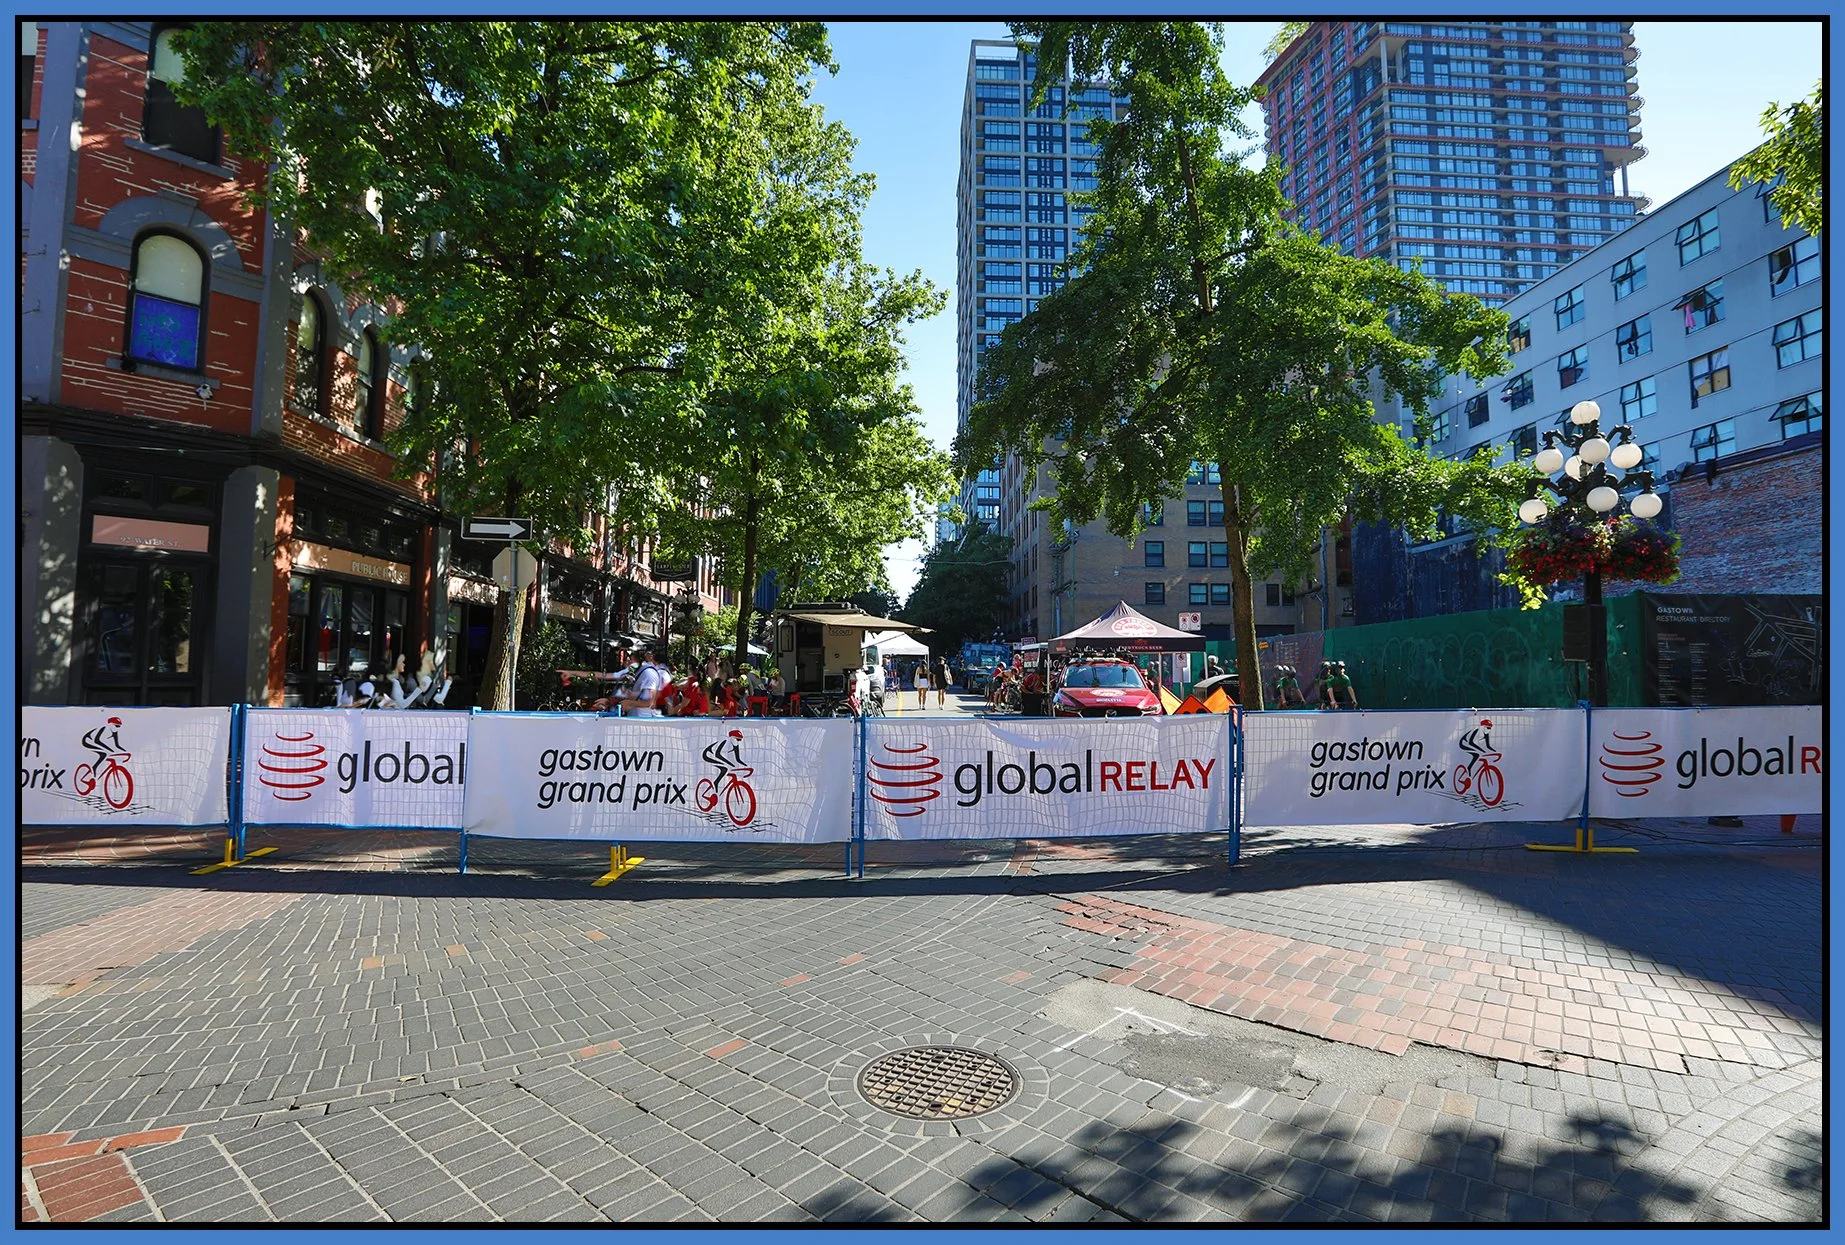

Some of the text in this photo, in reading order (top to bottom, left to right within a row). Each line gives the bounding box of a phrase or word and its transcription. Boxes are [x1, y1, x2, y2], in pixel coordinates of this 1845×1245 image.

[134, 538, 165, 546] WATER
[352, 561, 408, 582] PUBLIC HOUSE
[1655, 615, 1697, 623] RESTAURANT
[1657, 606, 1694, 614] GASTOWN
[337, 740, 465, 793] global
[538, 745, 664, 777] gastown
[1310, 737, 1423, 768] gastown
[537, 775, 688, 811] grand prix
[1310, 764, 1446, 797] grand prix
